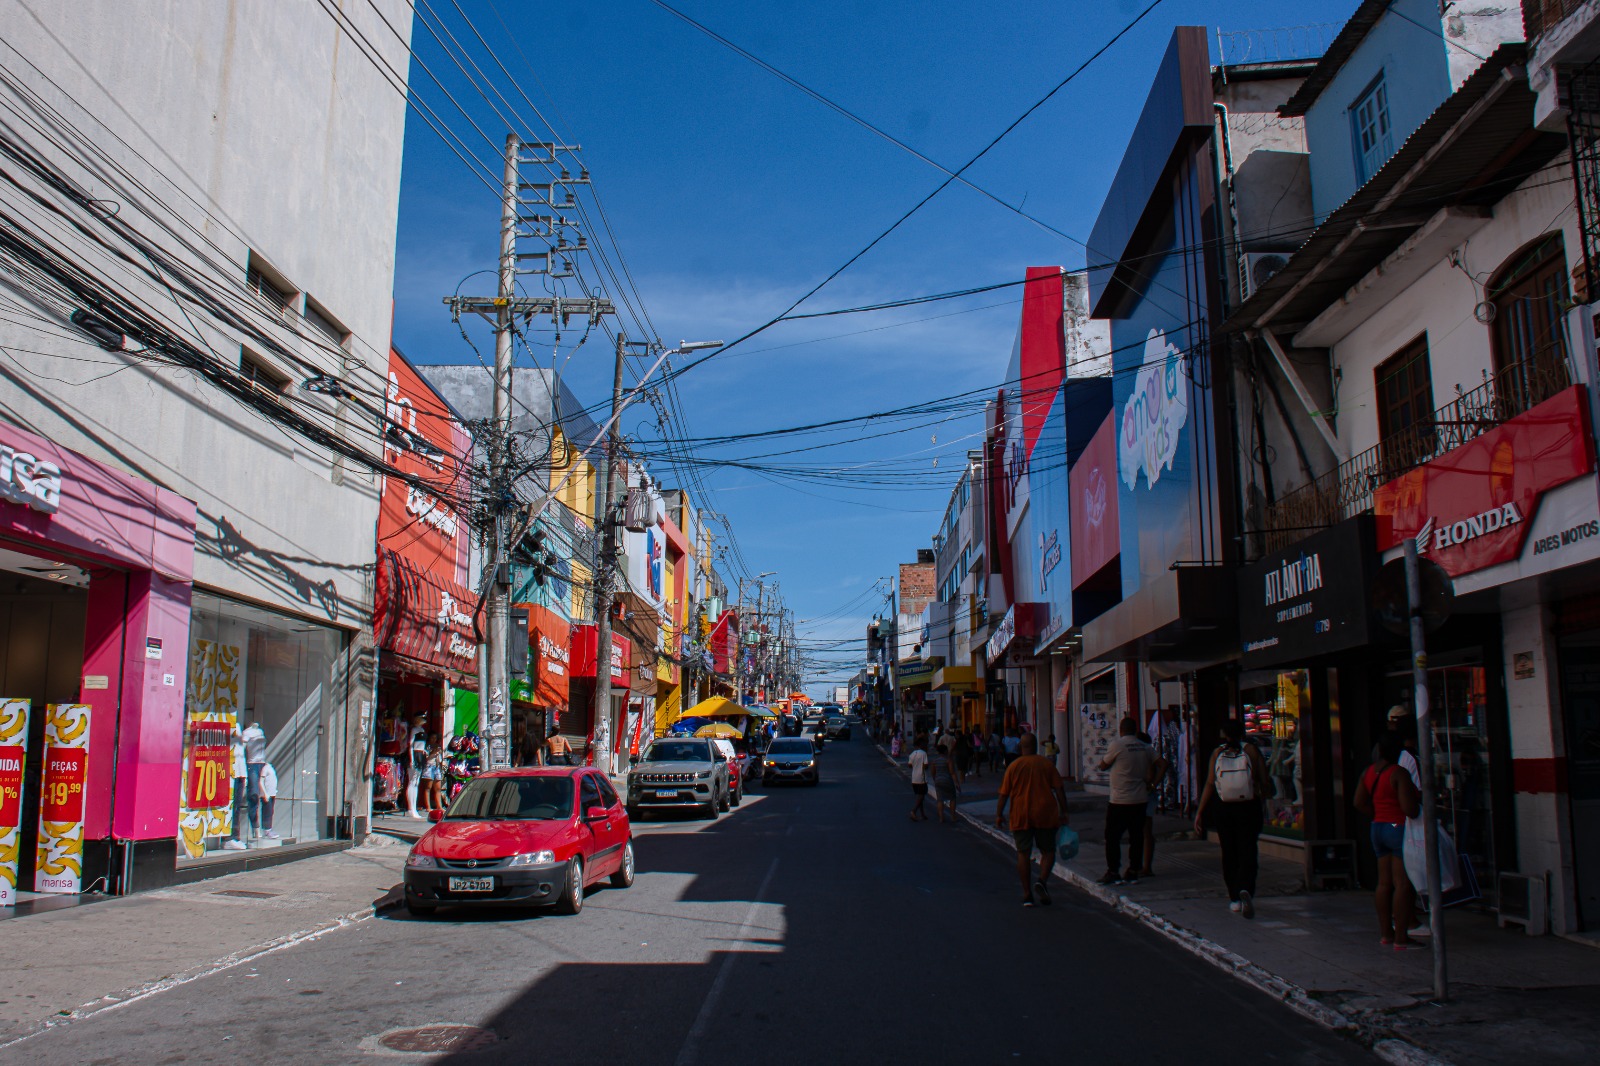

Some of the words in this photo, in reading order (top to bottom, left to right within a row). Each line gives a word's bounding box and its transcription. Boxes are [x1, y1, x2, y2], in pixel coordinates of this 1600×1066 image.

[1434, 501, 1524, 550] HONDA
[1533, 538, 1560, 556] ARES
[1561, 519, 1600, 546] MOTOS
[1276, 601, 1313, 623] SUPLEMENTOS
[195, 728, 227, 748] LIQUIDA
[51, 760, 78, 772] PEÇAS
[195, 759, 226, 801] 70%
[48, 782, 81, 806] 19,99
[42, 878, 73, 888] marisa
